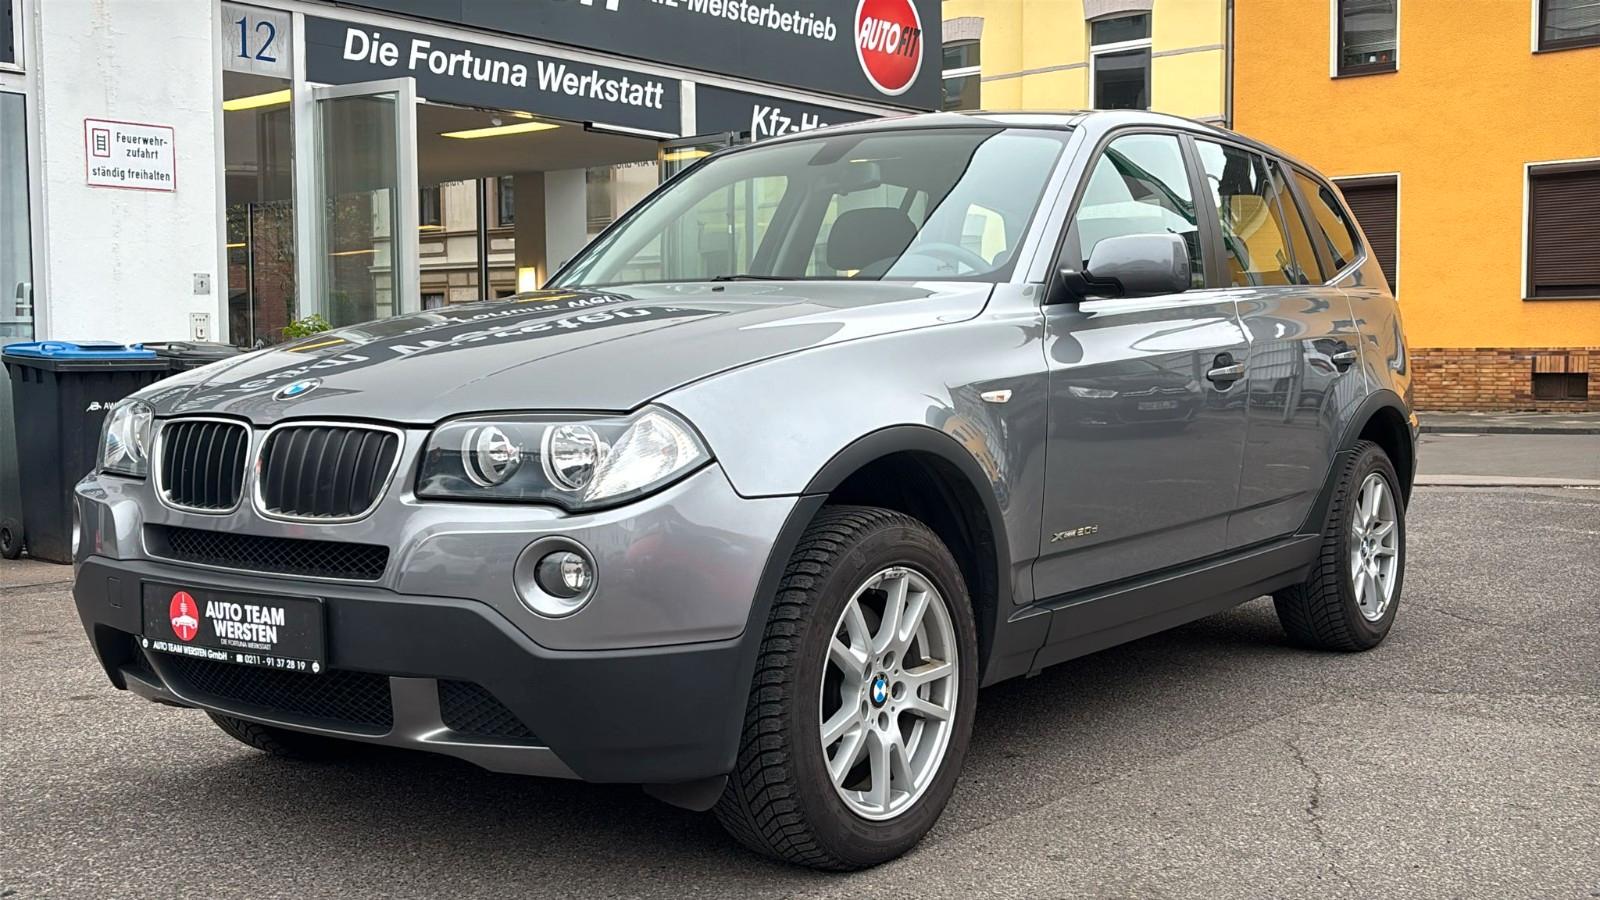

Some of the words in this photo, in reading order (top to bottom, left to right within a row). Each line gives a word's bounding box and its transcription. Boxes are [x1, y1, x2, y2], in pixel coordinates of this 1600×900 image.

[651, 0, 837, 41] Meisterbetrieb
[234, 16, 277, 63] 12
[860, 16, 921, 58] AUTOFIT
[343, 27, 399, 67] Die
[408, 38, 527, 88] Fortuna
[537, 60, 664, 110] Werkstatt
[116, 131, 168, 147] Feuerwehr-
[126, 147, 159, 160] zufahrt
[92, 165, 125, 181] ständig
[127, 167, 171, 182] freihalten
[205, 600, 242, 621] AUTO
[244, 604, 285, 626] TEAM
[213, 619, 278, 644] WERSTEN
[153, 640, 167, 651] AUTO
[168, 643, 182, 654] TEAM
[183, 645, 207, 657] WERSTEN
[207, 649, 227, 660] GmbH
[244, 654, 260, 664] 0211
[266, 657, 274, 667] 91
[276, 658, 285, 667] 37
[286, 660, 295, 669] 28
[297, 661, 306, 670] 19
